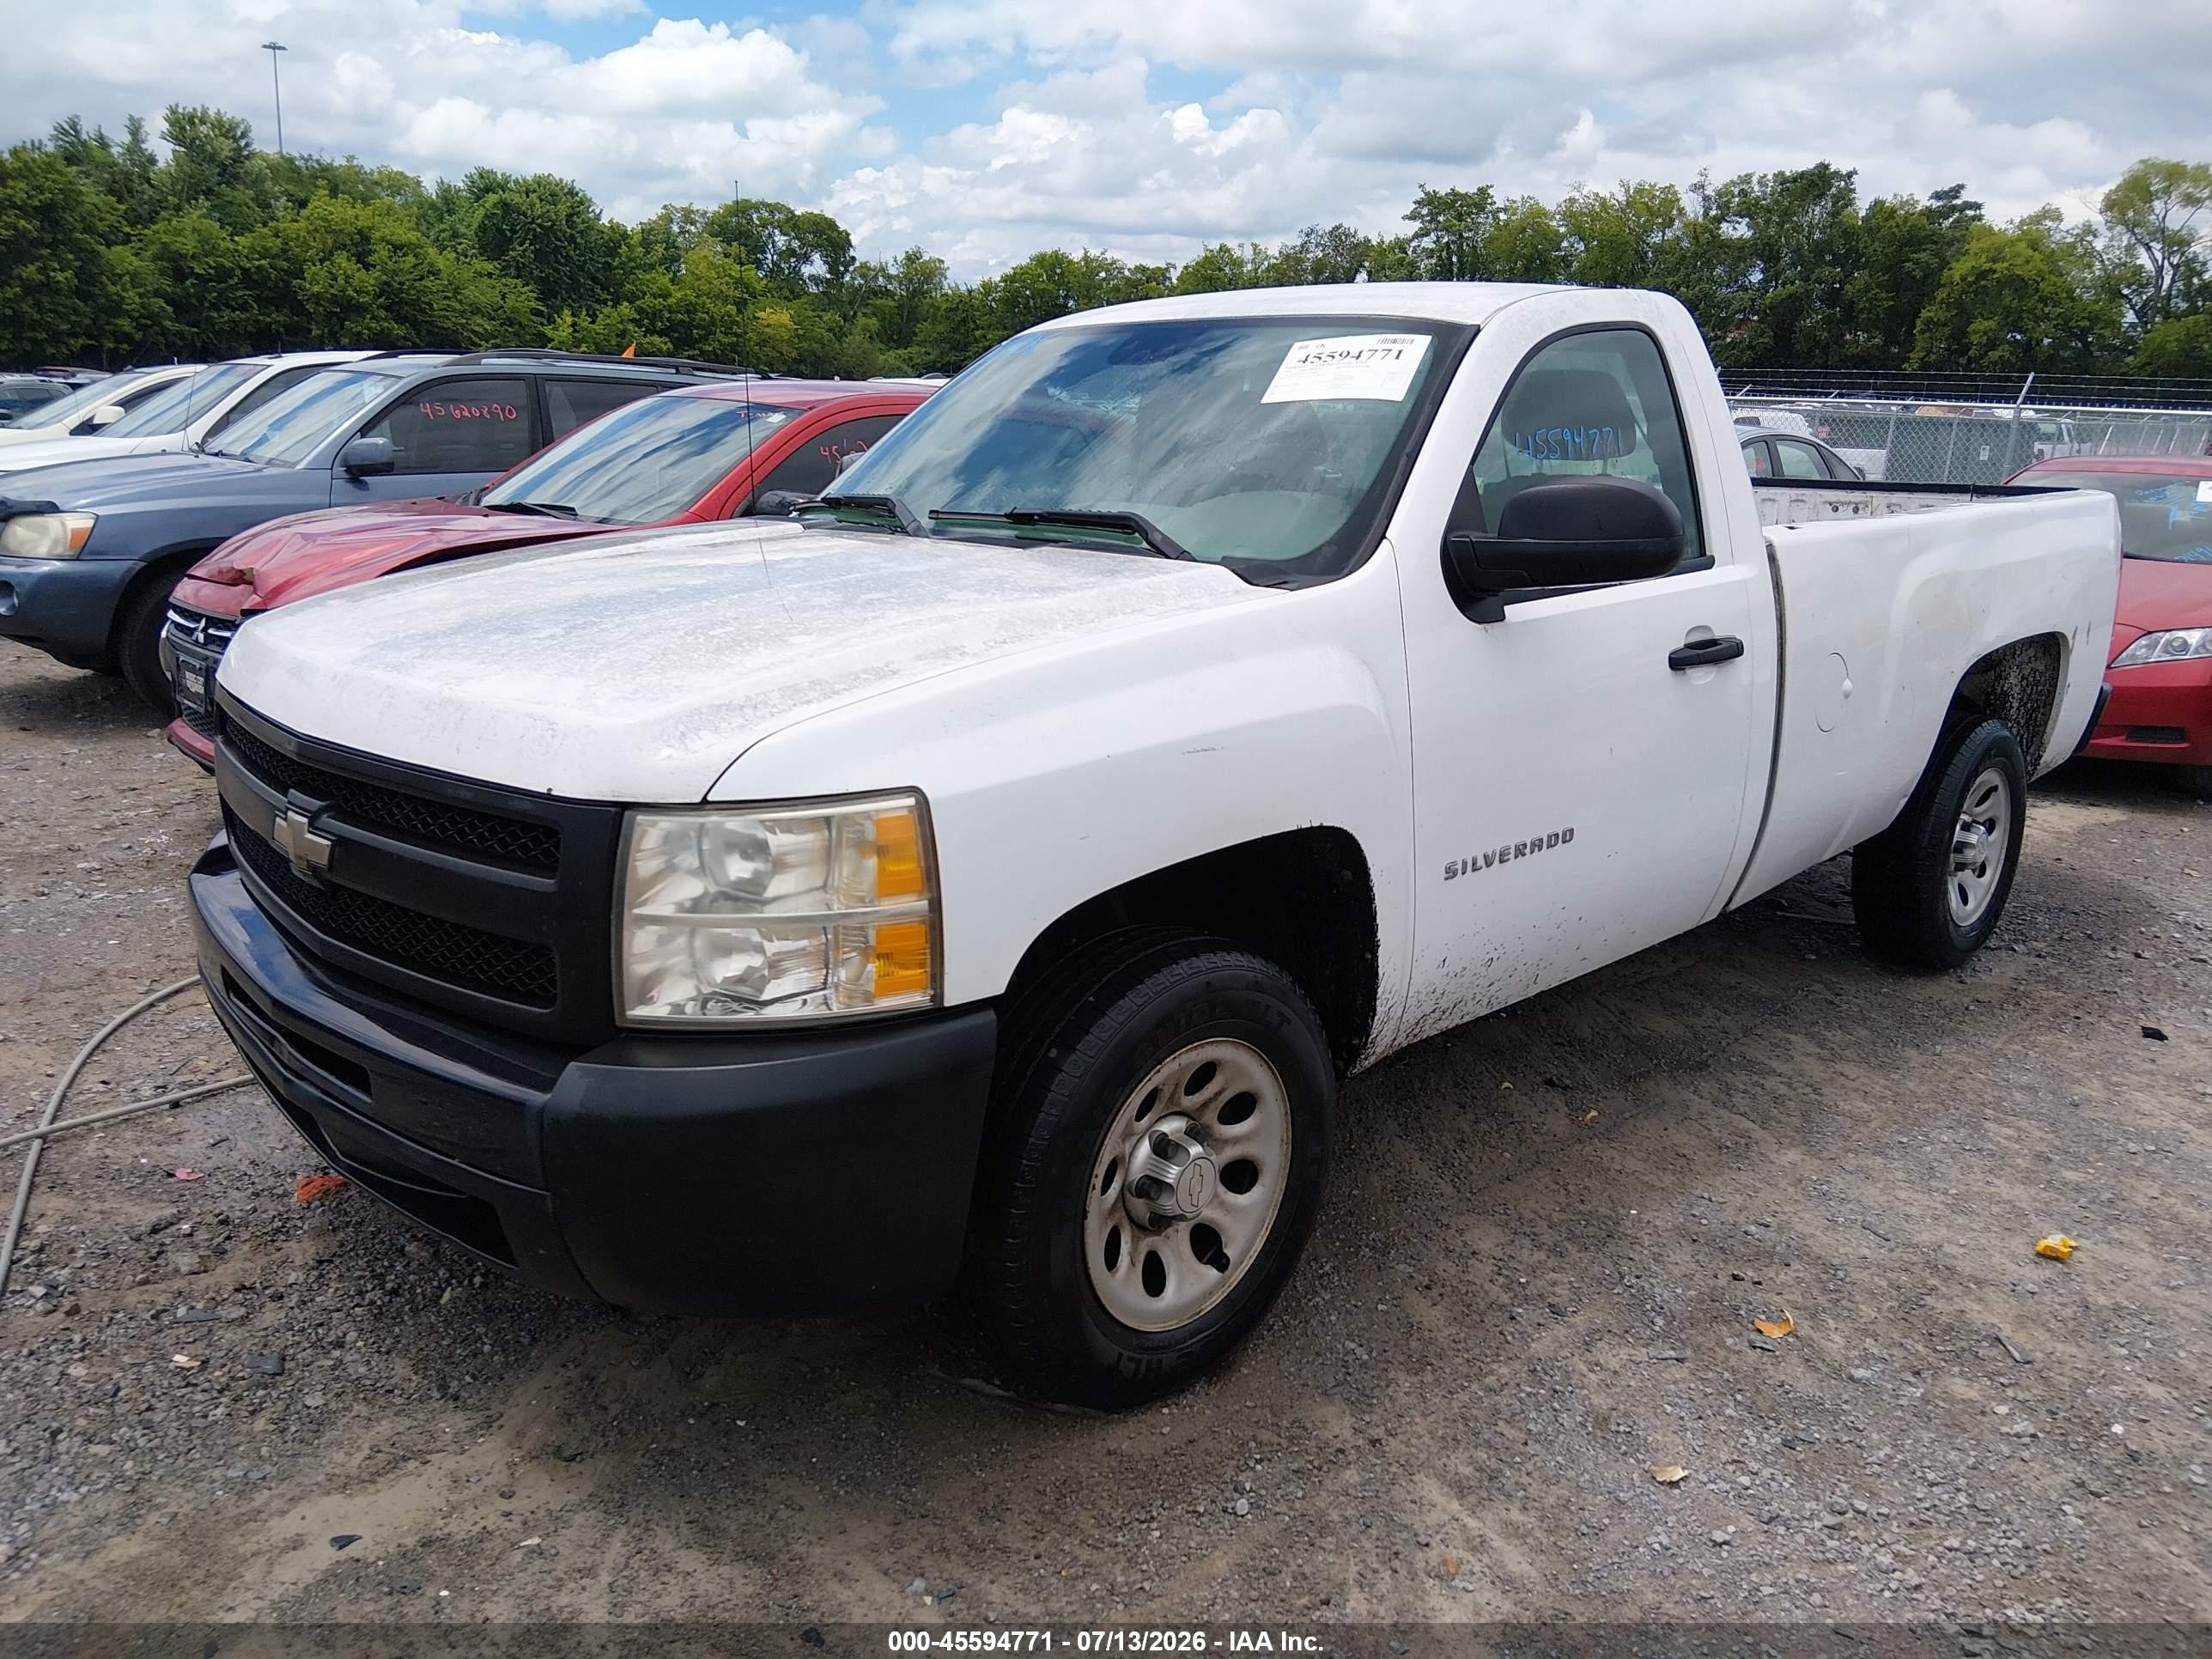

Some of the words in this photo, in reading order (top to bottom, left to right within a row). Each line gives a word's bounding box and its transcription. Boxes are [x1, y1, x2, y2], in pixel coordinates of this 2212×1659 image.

[1297, 349, 1404, 364] 45594771
[419, 403, 517, 421] 45620890
[1514, 426, 1623, 459] 45594771
[1443, 827, 1575, 881] SILVERADO
